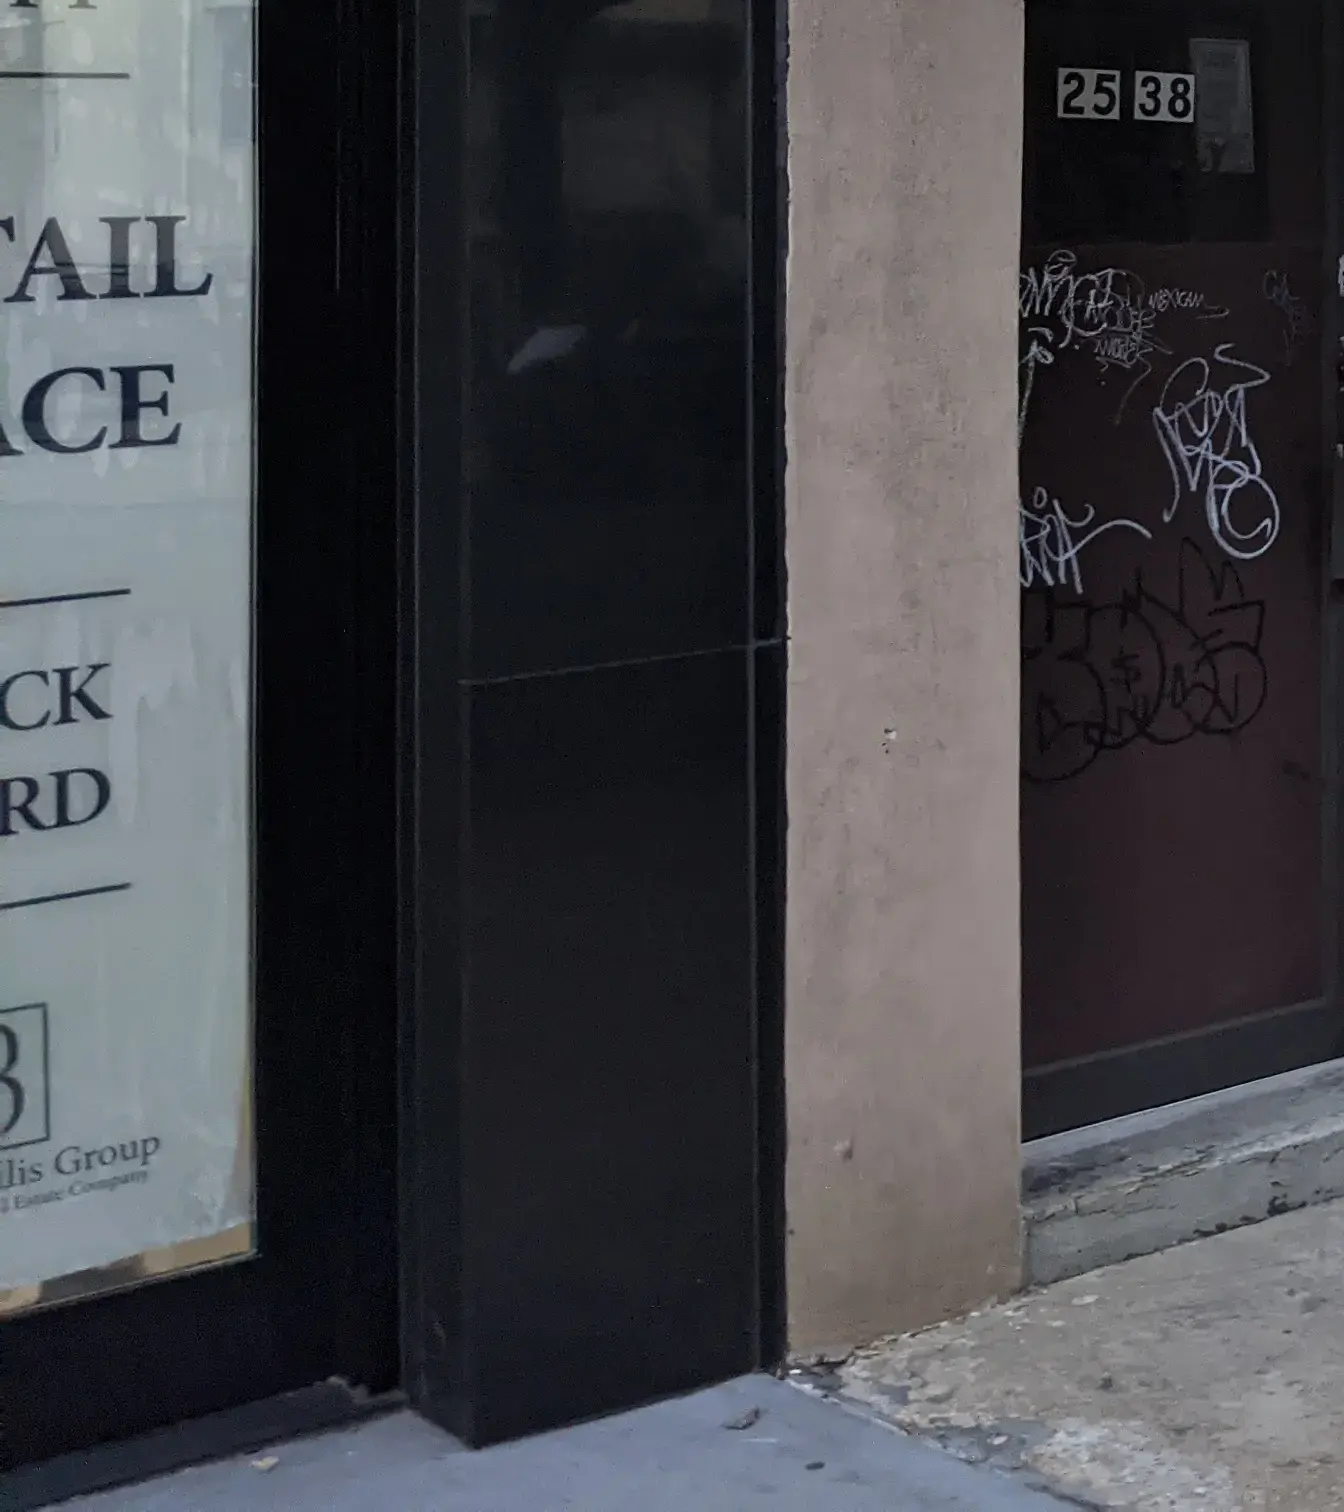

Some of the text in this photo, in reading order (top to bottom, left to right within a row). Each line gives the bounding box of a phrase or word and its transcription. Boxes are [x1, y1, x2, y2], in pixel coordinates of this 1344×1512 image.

[1063, 72, 1116, 115] 25
[1139, 75, 1191, 118] 38
[55, 1137, 160, 1176] Group
